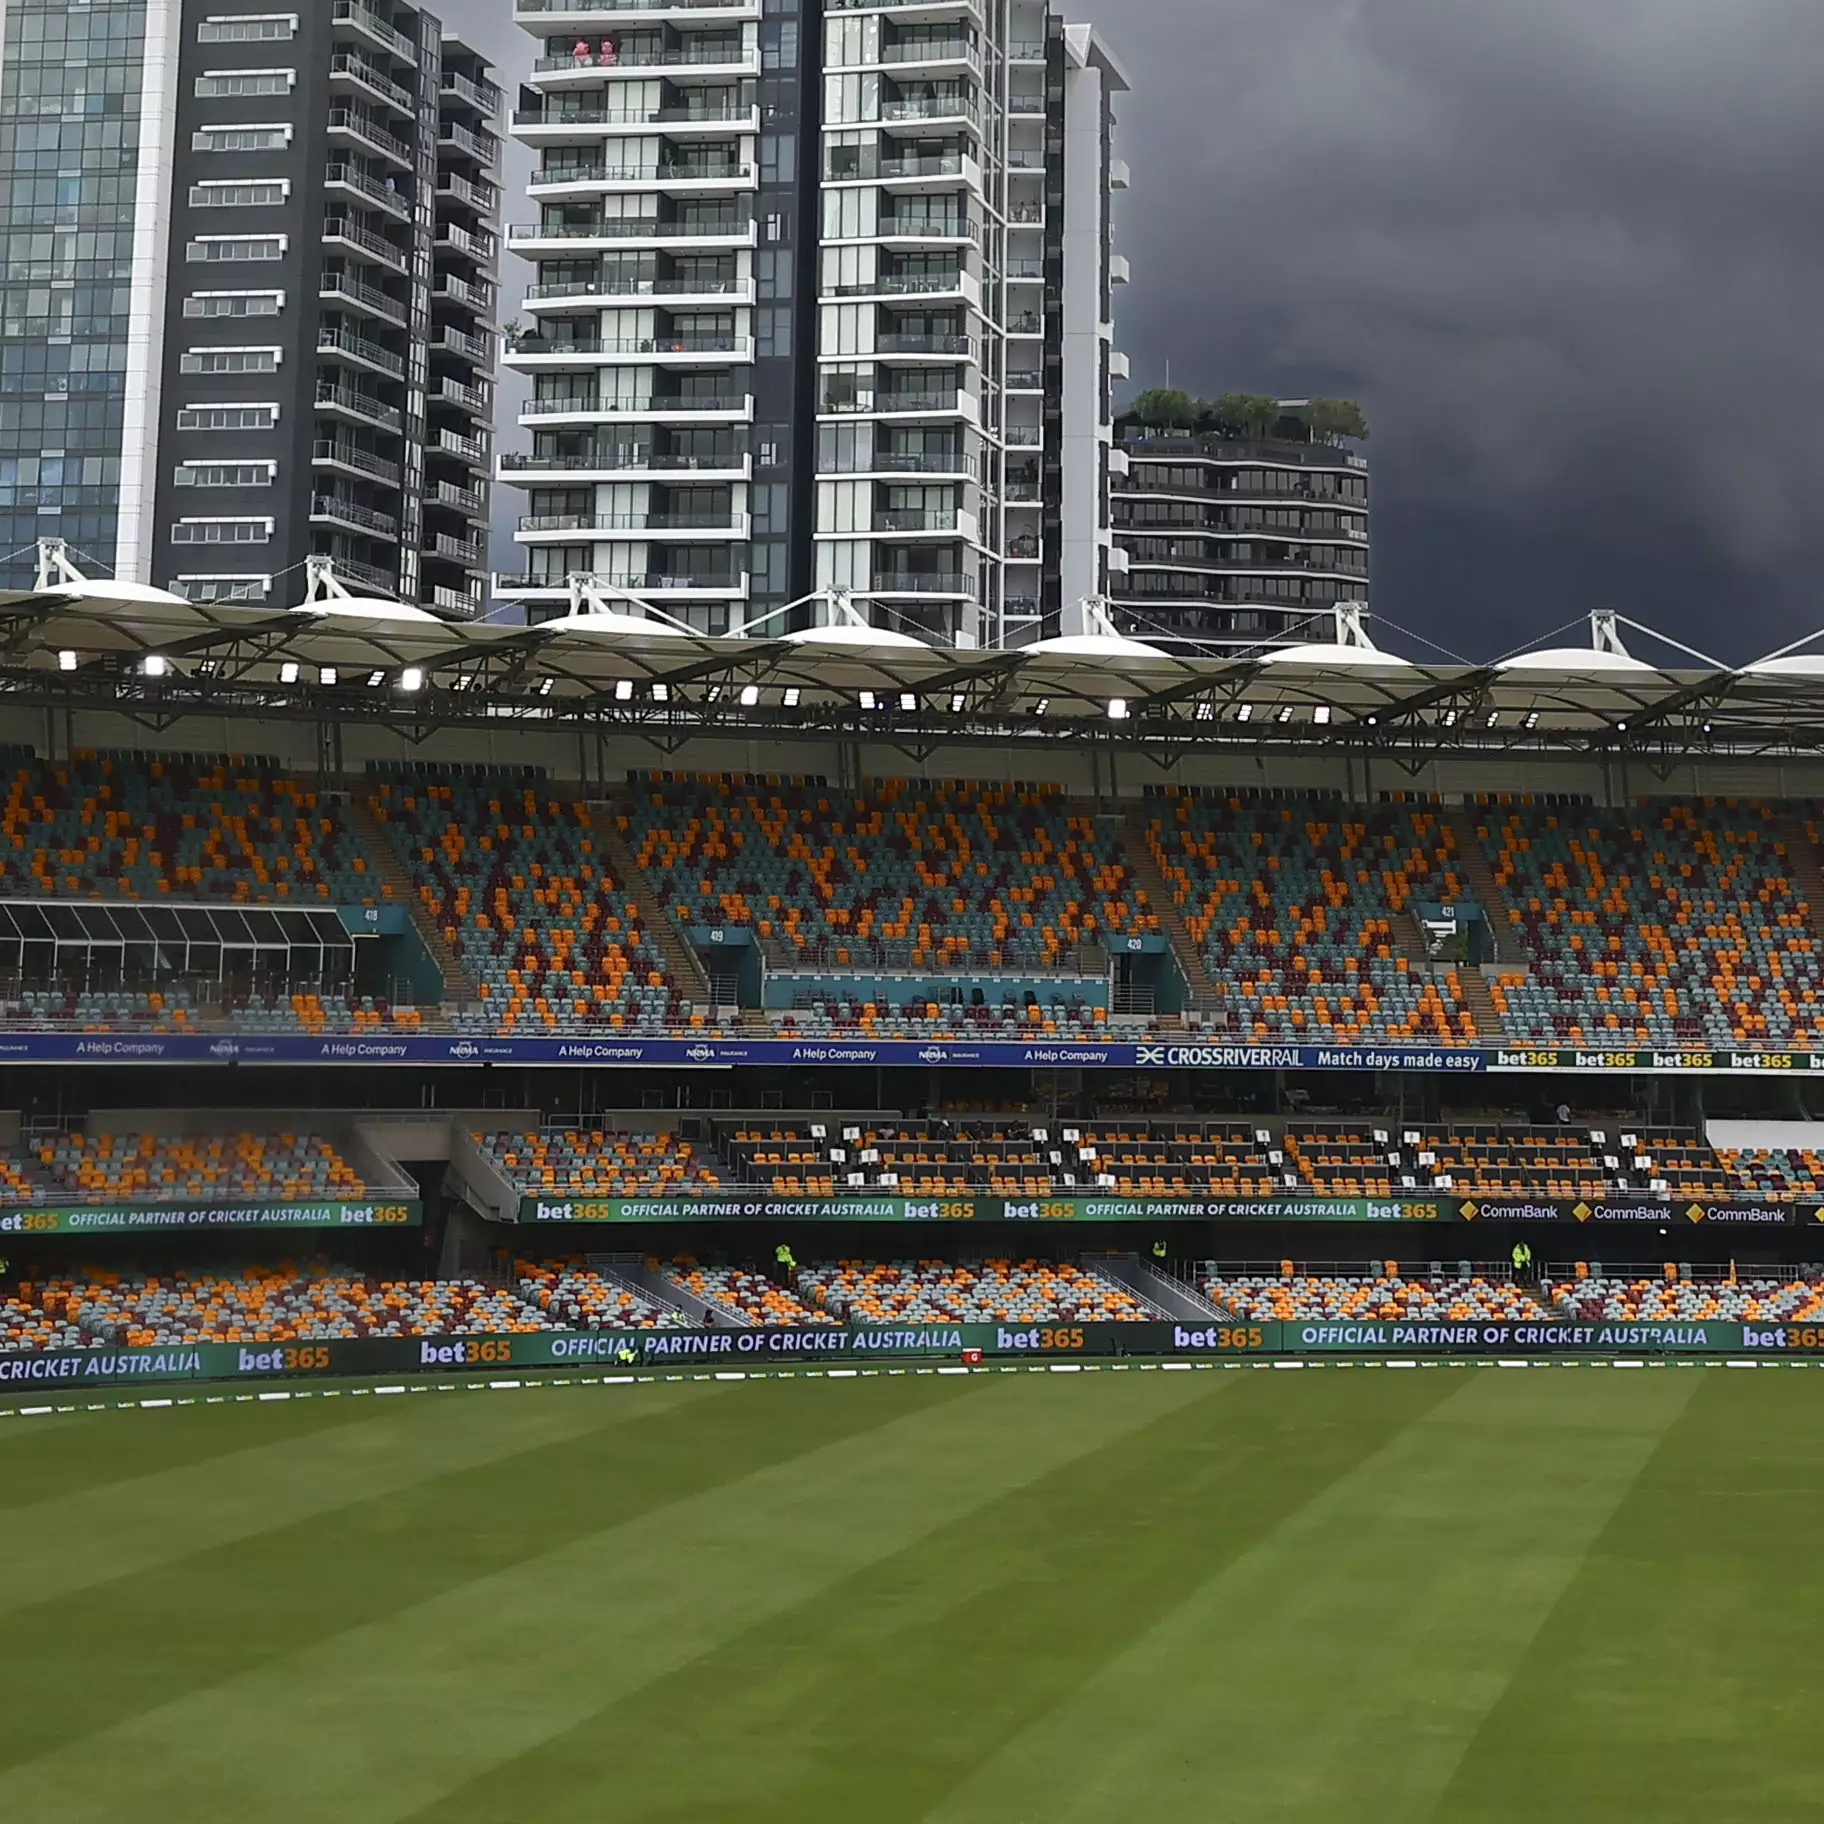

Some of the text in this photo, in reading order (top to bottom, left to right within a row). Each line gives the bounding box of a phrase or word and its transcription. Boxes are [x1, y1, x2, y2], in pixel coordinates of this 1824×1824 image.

[1442, 906, 1456, 917] 421
[1127, 939, 1142, 950] 420
[87, 1042, 110, 1056] Help
[114, 1042, 164, 1057] Company
[792, 1049, 876, 1063] A Help Company
[918, 1050, 947, 1061] NRMA
[1318, 1052, 1479, 1072] Match days made easy
[1575, 1052, 1636, 1068] bet365
[621, 1203, 894, 1216] OFFICIAL PARTNER OF CRICKET AUSTRALIA
[1004, 1201, 1075, 1220] bet365
[1481, 1203, 1558, 1221] CommBank
[1707, 1205, 1785, 1223] CommBank
[1302, 1326, 1707, 1345] OFFICIAL PARTNER OF CRICKET AUSTRALIA
[420, 1340, 511, 1364] bet365
[85, 1354, 200, 1375] AUSTRALIA
